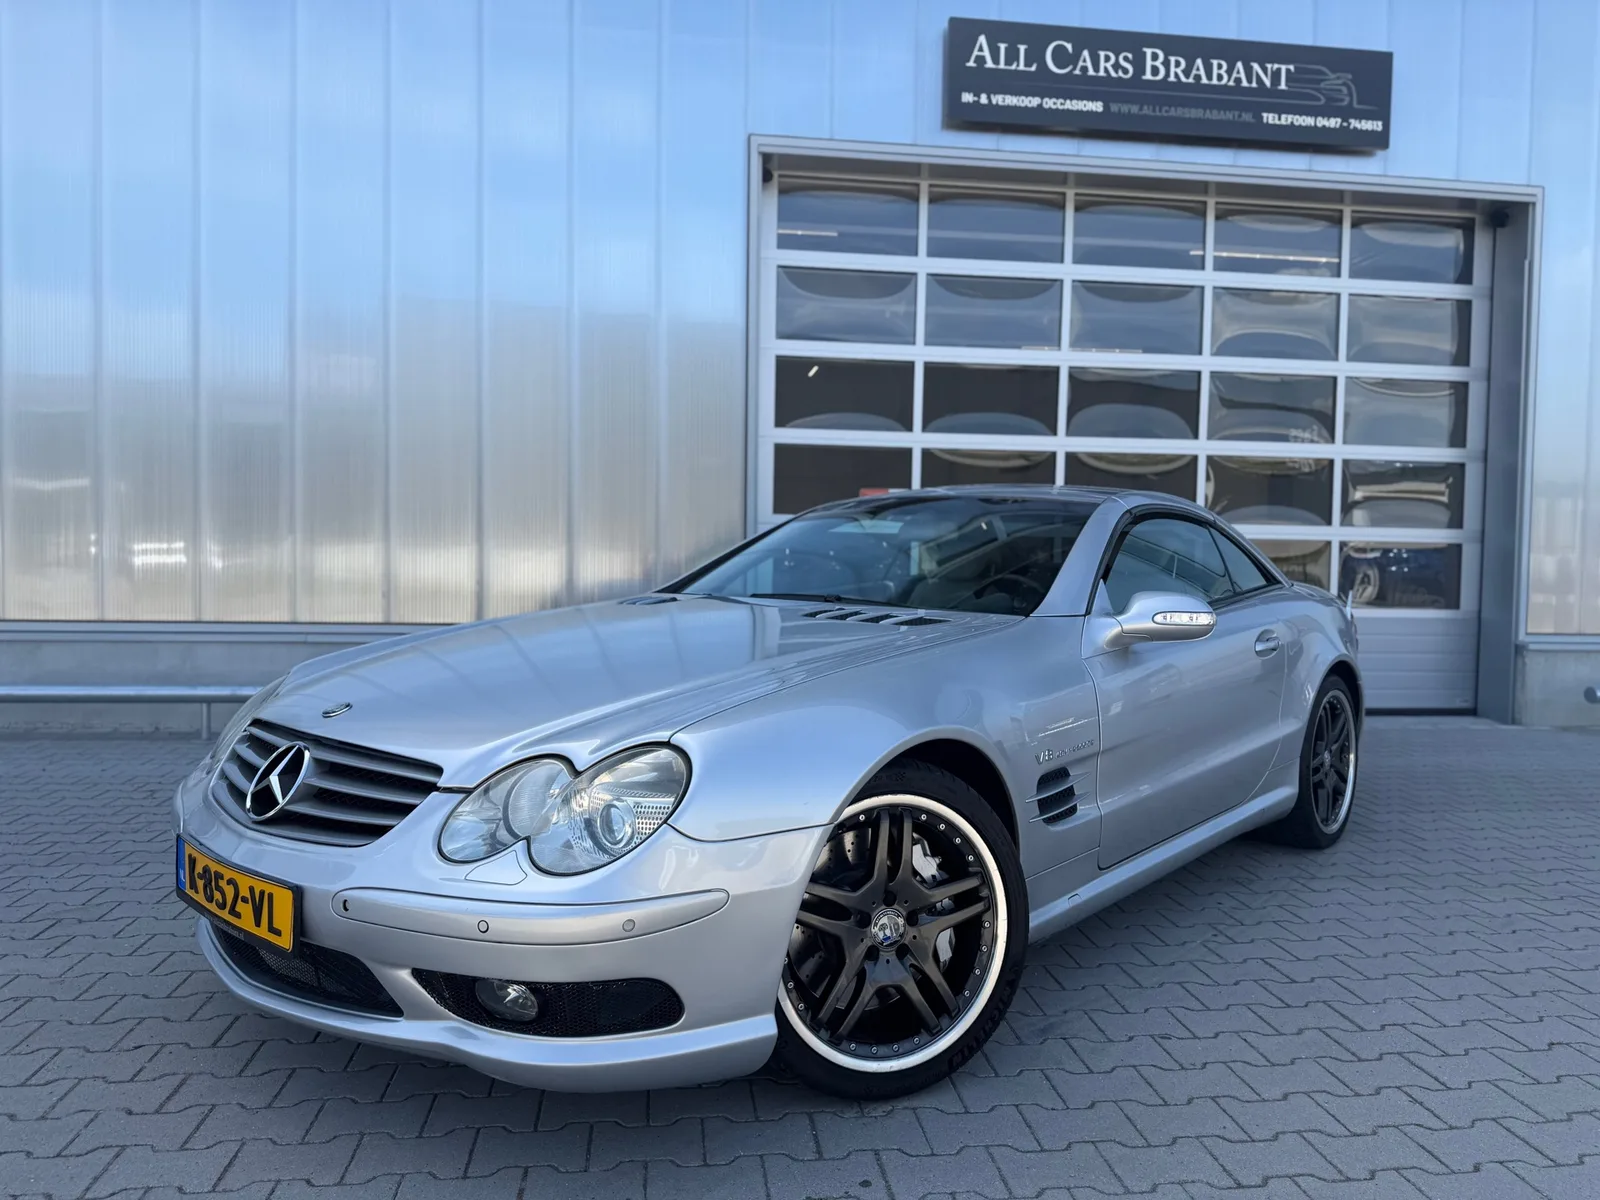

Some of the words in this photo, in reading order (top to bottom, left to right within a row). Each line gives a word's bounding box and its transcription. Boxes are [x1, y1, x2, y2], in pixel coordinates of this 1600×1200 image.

[965, 34, 1037, 71] ALL
[1045, 40, 1134, 79] CARS
[1141, 47, 1295, 89] BRABANT
[961, 92, 978, 103] IN-
[980, 93, 988, 104] &
[990, 94, 1042, 108] VERKOOP
[1043, 97, 1103, 112] OCCASIONS
[1109, 102, 1256, 122] WWW.ALLCARSBRABANT.NL
[1262, 113, 1315, 127] TELEFOON
[187, 853, 282, 937] K-852-VL
